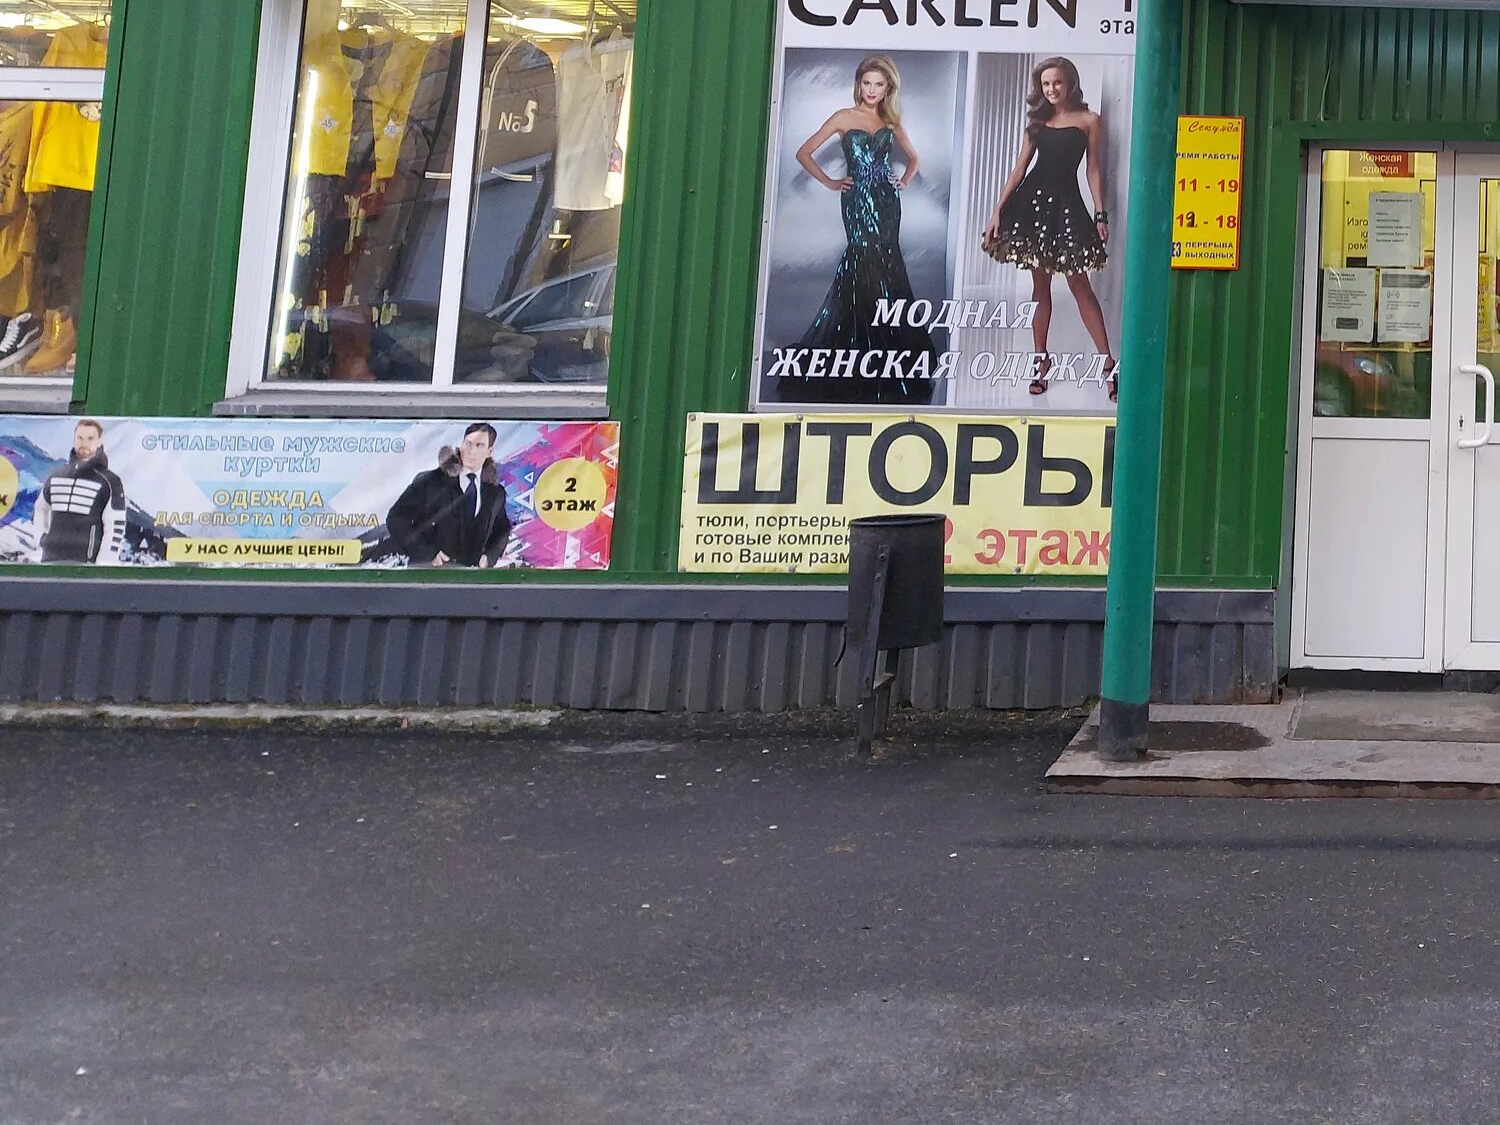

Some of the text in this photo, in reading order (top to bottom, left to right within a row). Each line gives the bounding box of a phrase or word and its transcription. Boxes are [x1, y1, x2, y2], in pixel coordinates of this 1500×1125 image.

[1100, 19, 1135, 35] эта
[1188, 120, 1240, 133] Секунда
[1362, 165, 1399, 175] одежда
[1178, 178, 1198, 192] 11
[1217, 179, 1238, 193] 19
[1216, 215, 1237, 228] 18
[1171, 241, 1233, 258] ЕЗ ПЕРЕРЫВА
[1347, 242, 1368, 252] рем
[1185, 251, 1234, 259] ВЫХОДНЫХ
[871, 298, 1039, 333] МОДНАЯ
[766, 347, 961, 380] ЖЕНСКАЯ
[224, 456, 320, 477] куртки
[697, 422, 1116, 508] ШТОРЫ
[564, 477, 577, 492] 2
[213, 490, 323, 510] ОДЕЖДА
[541, 499, 596, 511] этаж
[154, 511, 379, 528] ДЛЯ СПОРТА И ОТДЫХА
[697, 516, 749, 529] тюли,
[696, 534, 771, 545] готовые
[184, 544, 345, 557] У НАС ЛУЧШИЕ ЦЕНЫ!
[694, 552, 704, 563] и
[711, 552, 733, 563] по
[739, 549, 803, 563] Вашим
